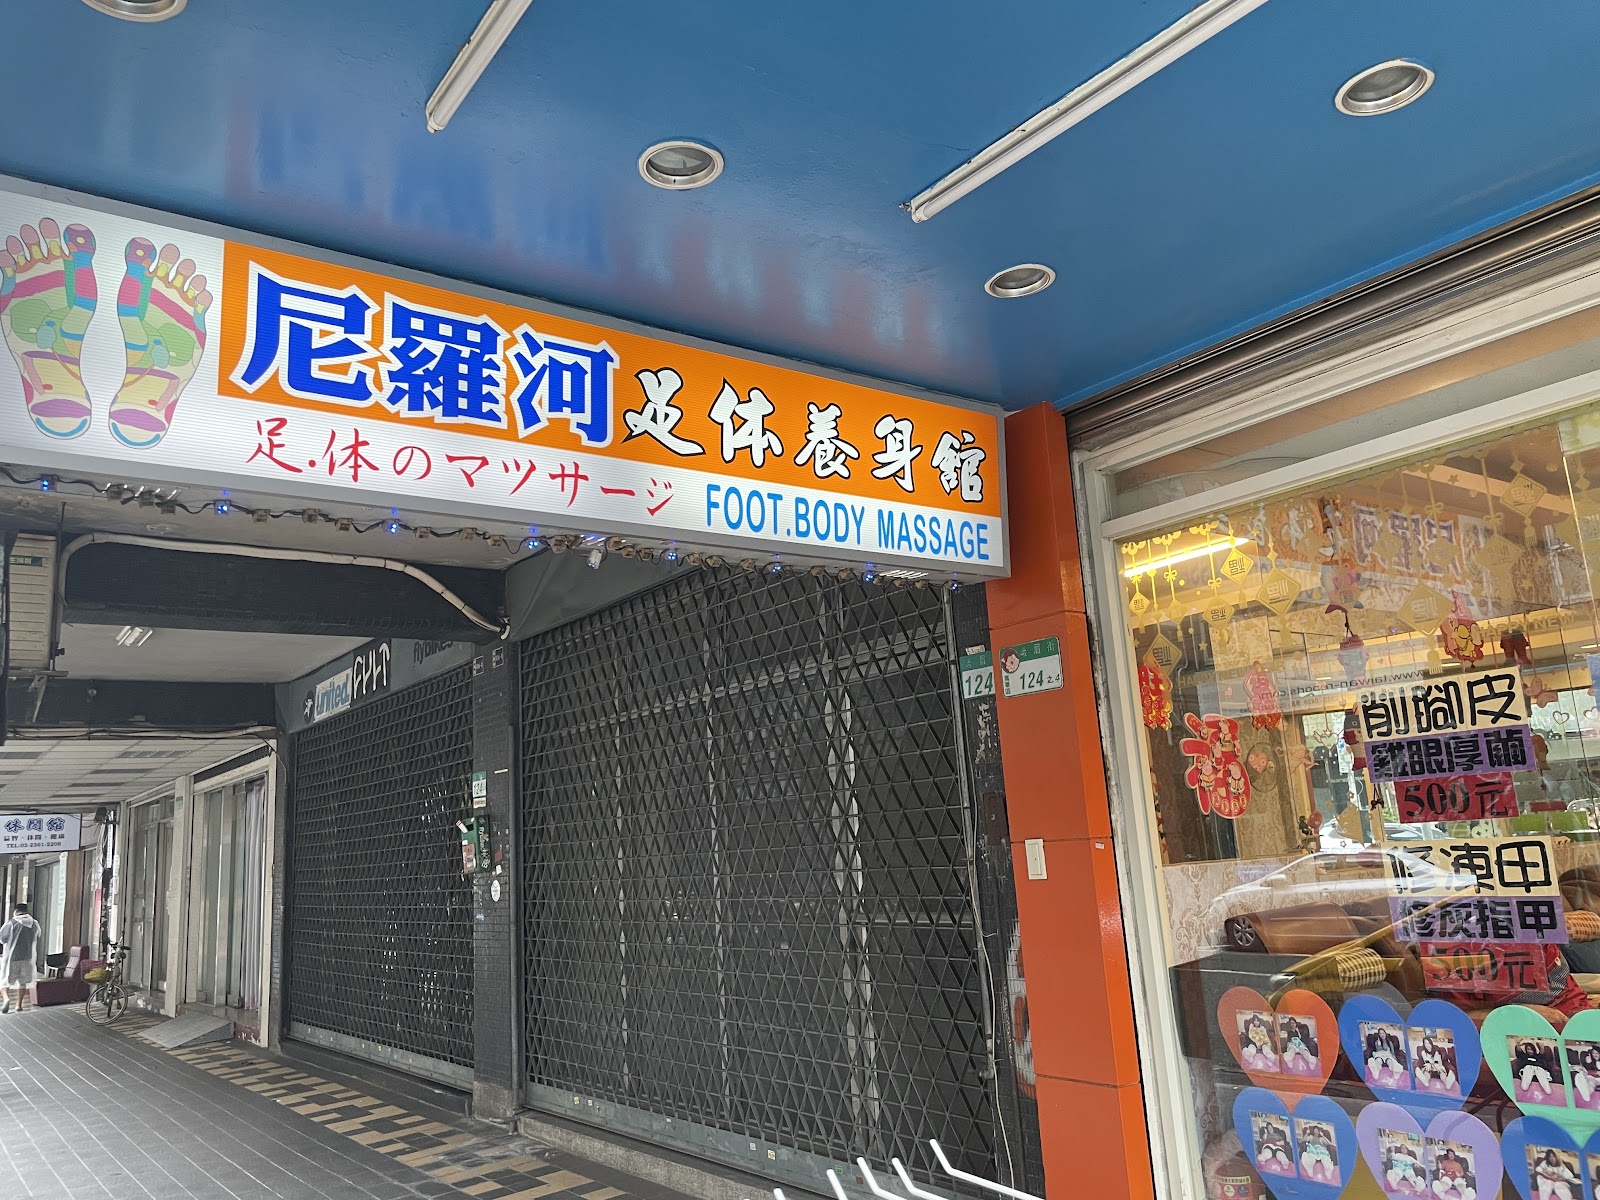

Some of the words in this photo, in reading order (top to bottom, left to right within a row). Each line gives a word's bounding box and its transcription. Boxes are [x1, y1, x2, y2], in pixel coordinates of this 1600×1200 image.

[232, 264, 620, 447] 尼羅河
[621, 367, 986, 503] 足体養身館
[706, 483, 865, 546] FOOT.BODY
[877, 508, 990, 561] MASSAGE
[965, 671, 993, 695] 124
[1361, 673, 1522, 739] 削腳皮
[1404, 779, 1509, 818] 500元
[1429, 947, 1537, 990] 500元
